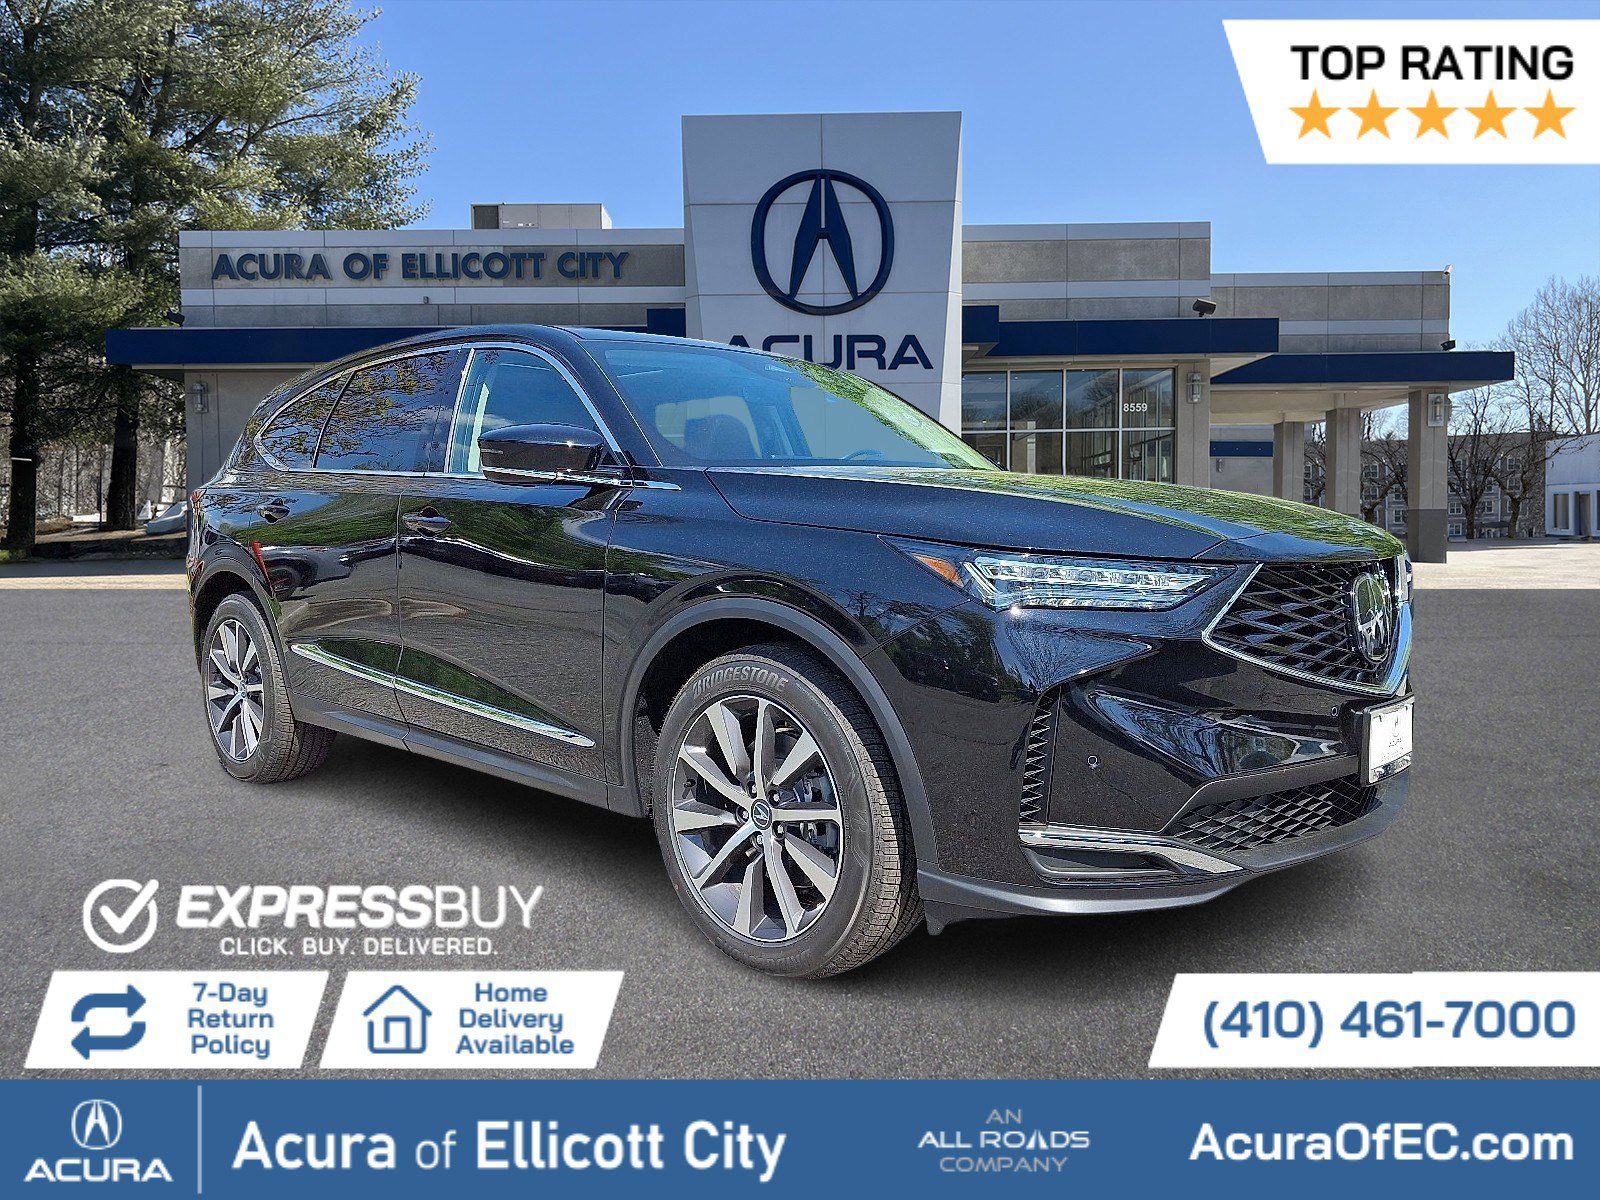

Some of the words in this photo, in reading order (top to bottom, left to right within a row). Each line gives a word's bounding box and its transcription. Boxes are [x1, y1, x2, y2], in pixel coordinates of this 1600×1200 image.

[212, 253, 333, 280] ACURA
[342, 252, 389, 279] OF
[401, 251, 546, 279] ELLICOTT
[557, 251, 630, 278] CITY
[1123, 402, 1148, 412] 8559
[692, 666, 789, 700] BRIDGESTONE
